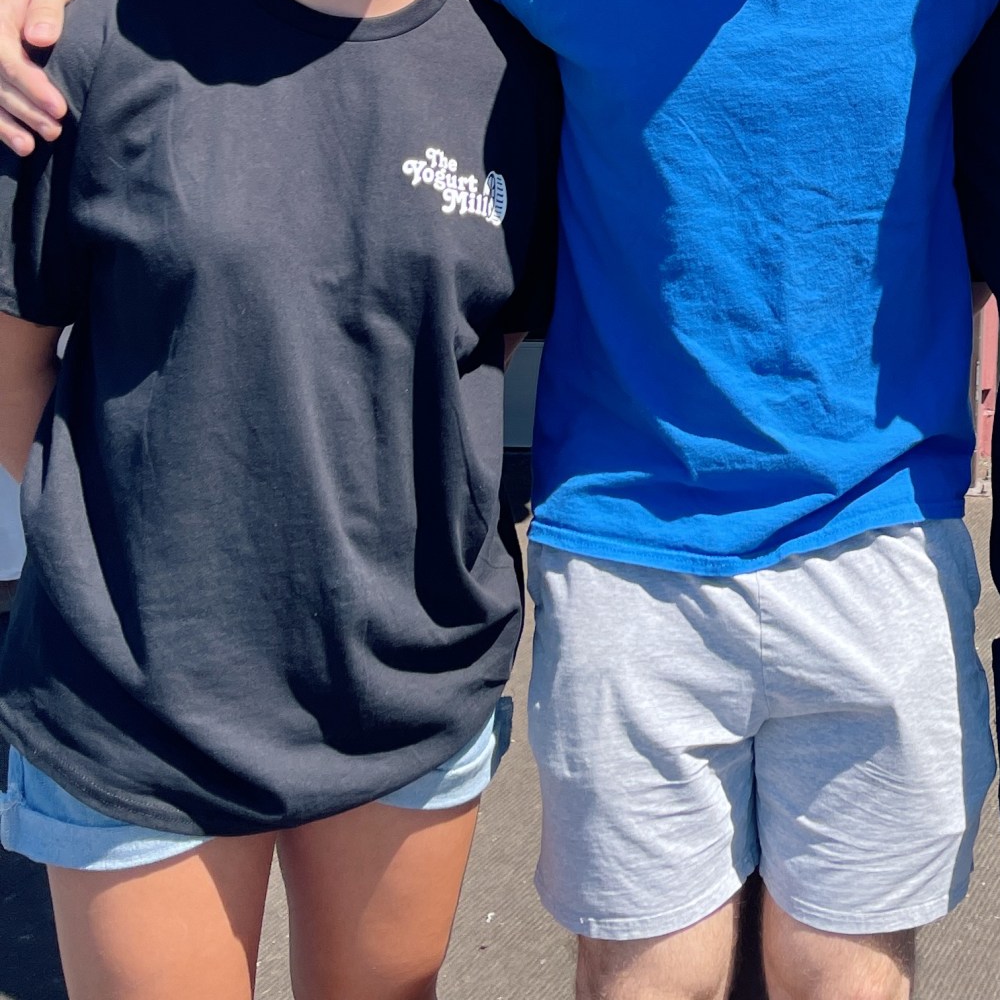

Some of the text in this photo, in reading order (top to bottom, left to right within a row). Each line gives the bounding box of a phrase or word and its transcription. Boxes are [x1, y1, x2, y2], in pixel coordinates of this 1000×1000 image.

[425, 147, 458, 172] The
[402, 159, 479, 193] Yogurt
[441, 188, 489, 217] Mill
